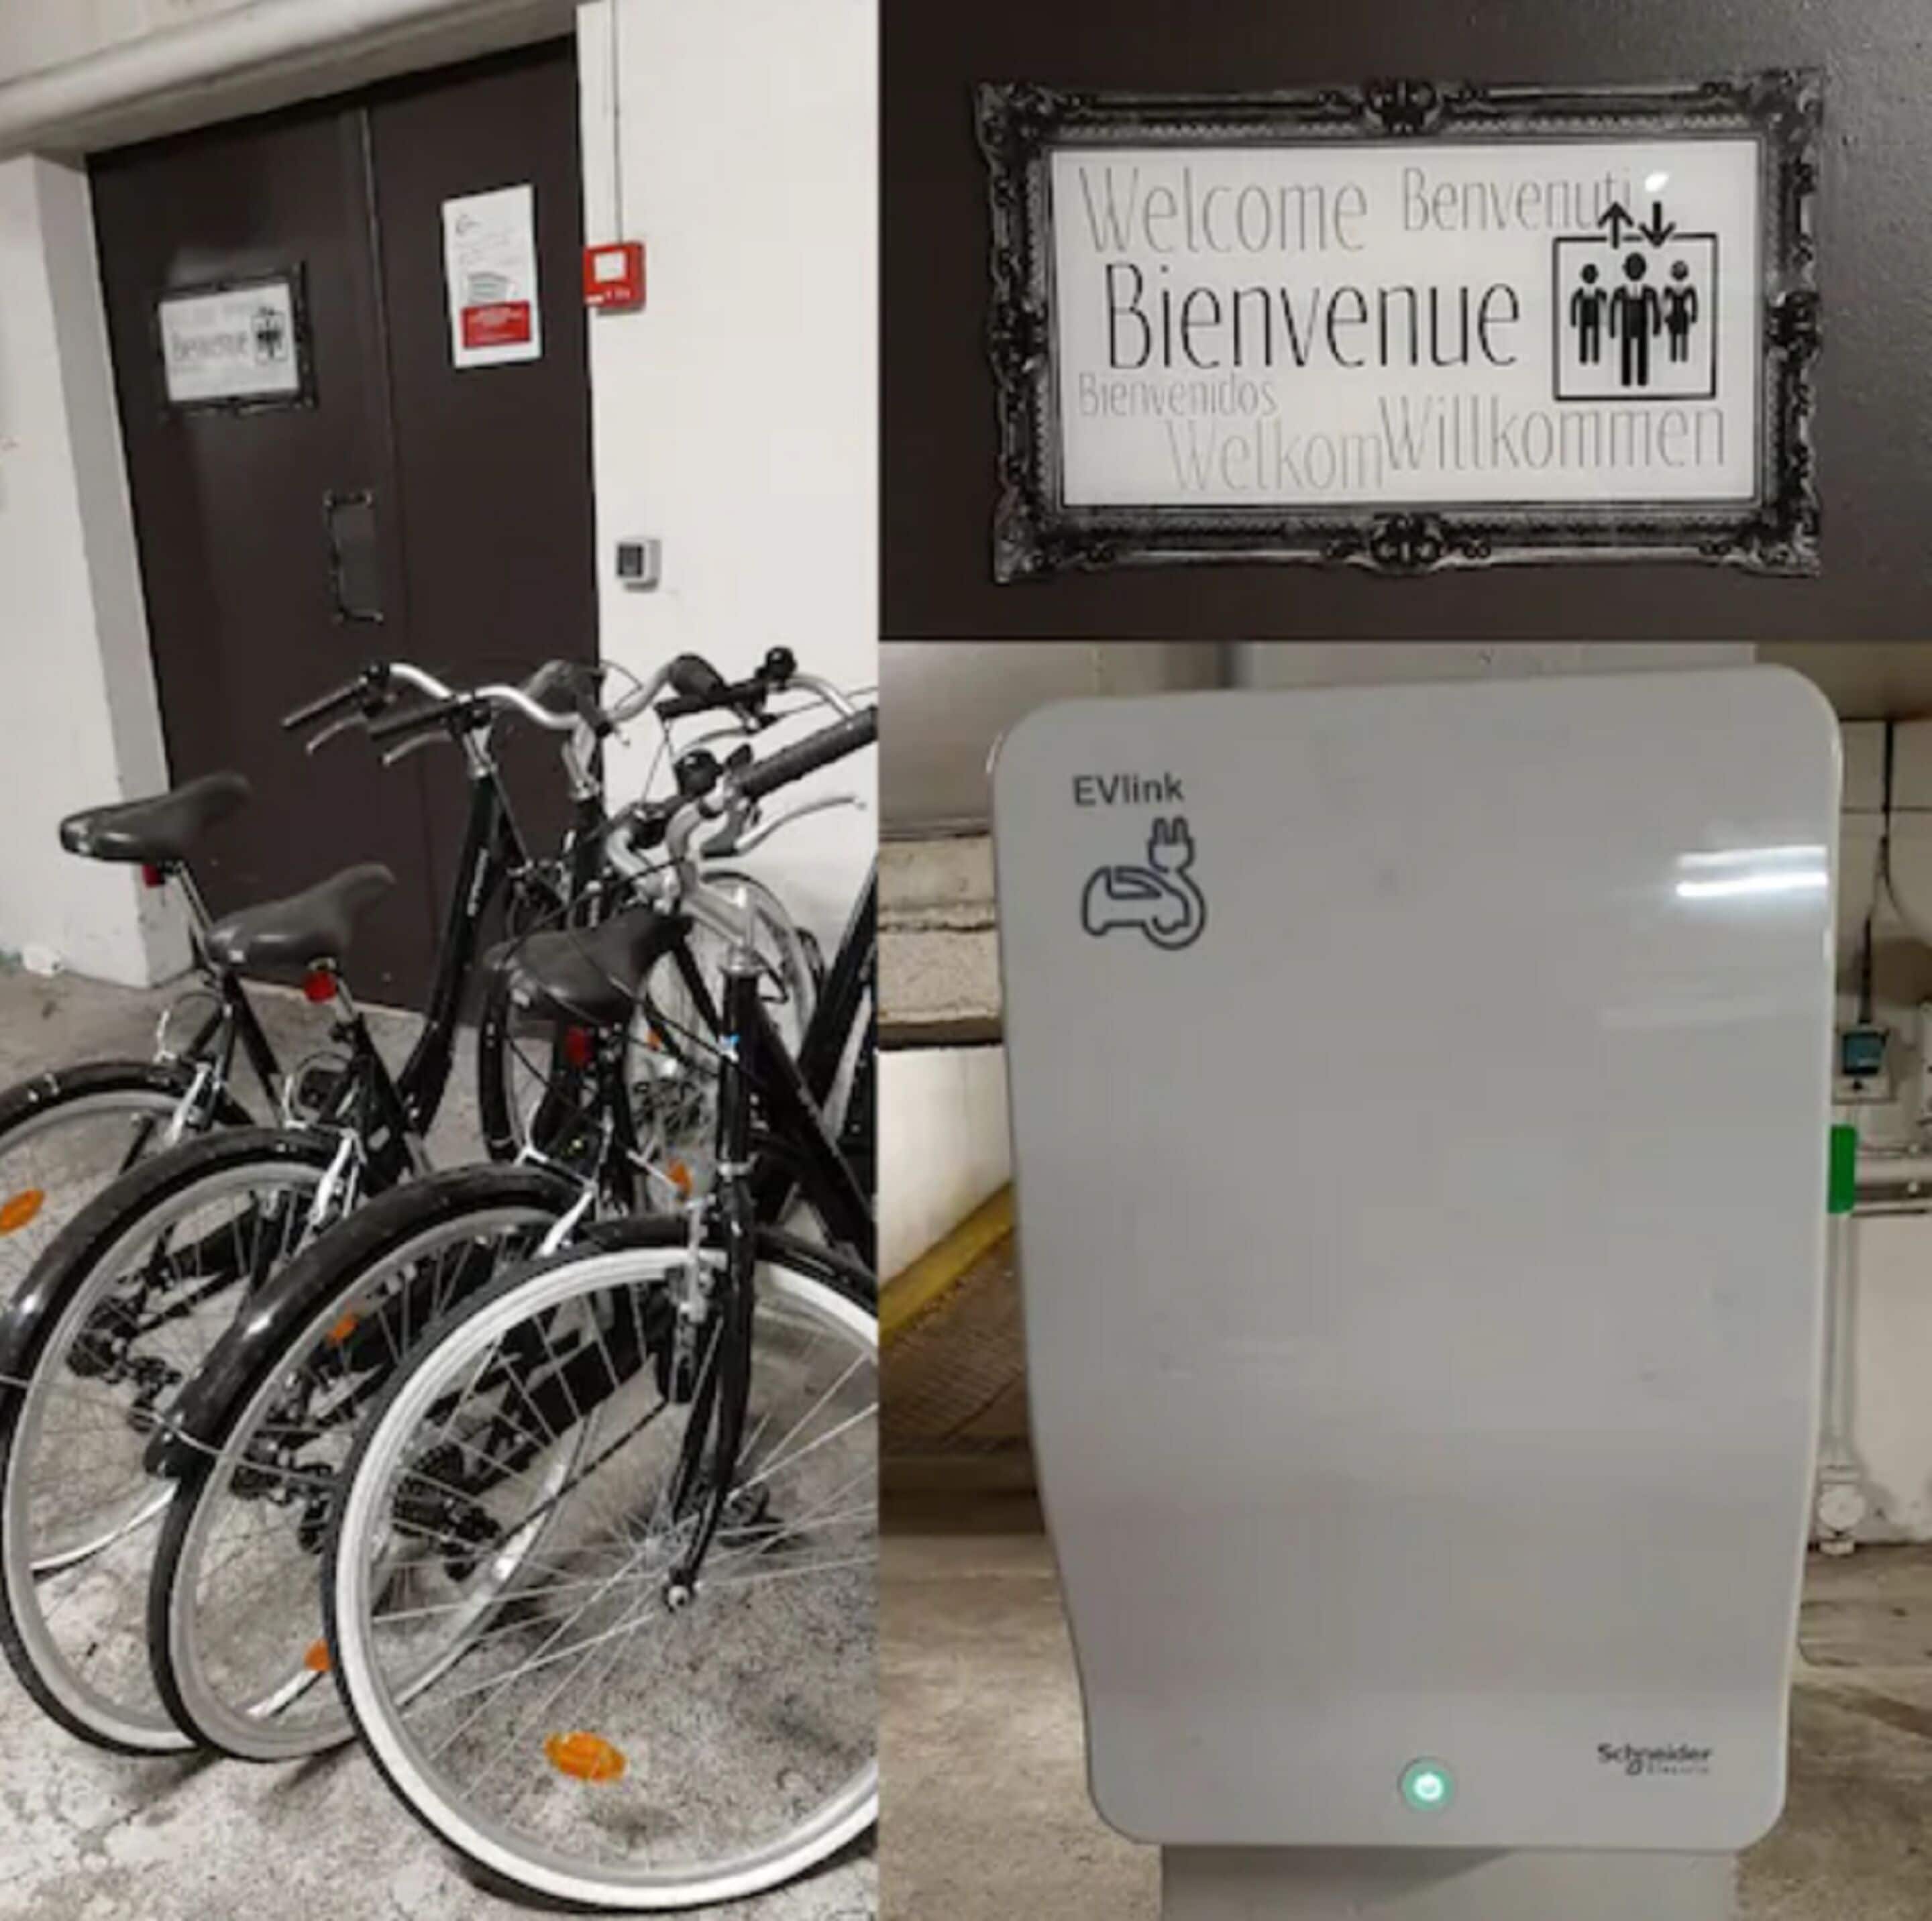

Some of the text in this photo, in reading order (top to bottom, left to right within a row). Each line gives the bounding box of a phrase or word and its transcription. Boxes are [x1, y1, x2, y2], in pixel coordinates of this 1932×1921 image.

[1077, 165, 1368, 254] Welcome
[1105, 263, 1520, 369] Bienvenue
[1078, 371, 1279, 418] Bienvenidos
[1163, 417, 1384, 491] Welkom
[1377, 395, 1725, 472] Willkommen
[1073, 773, 1184, 806] EVlink
